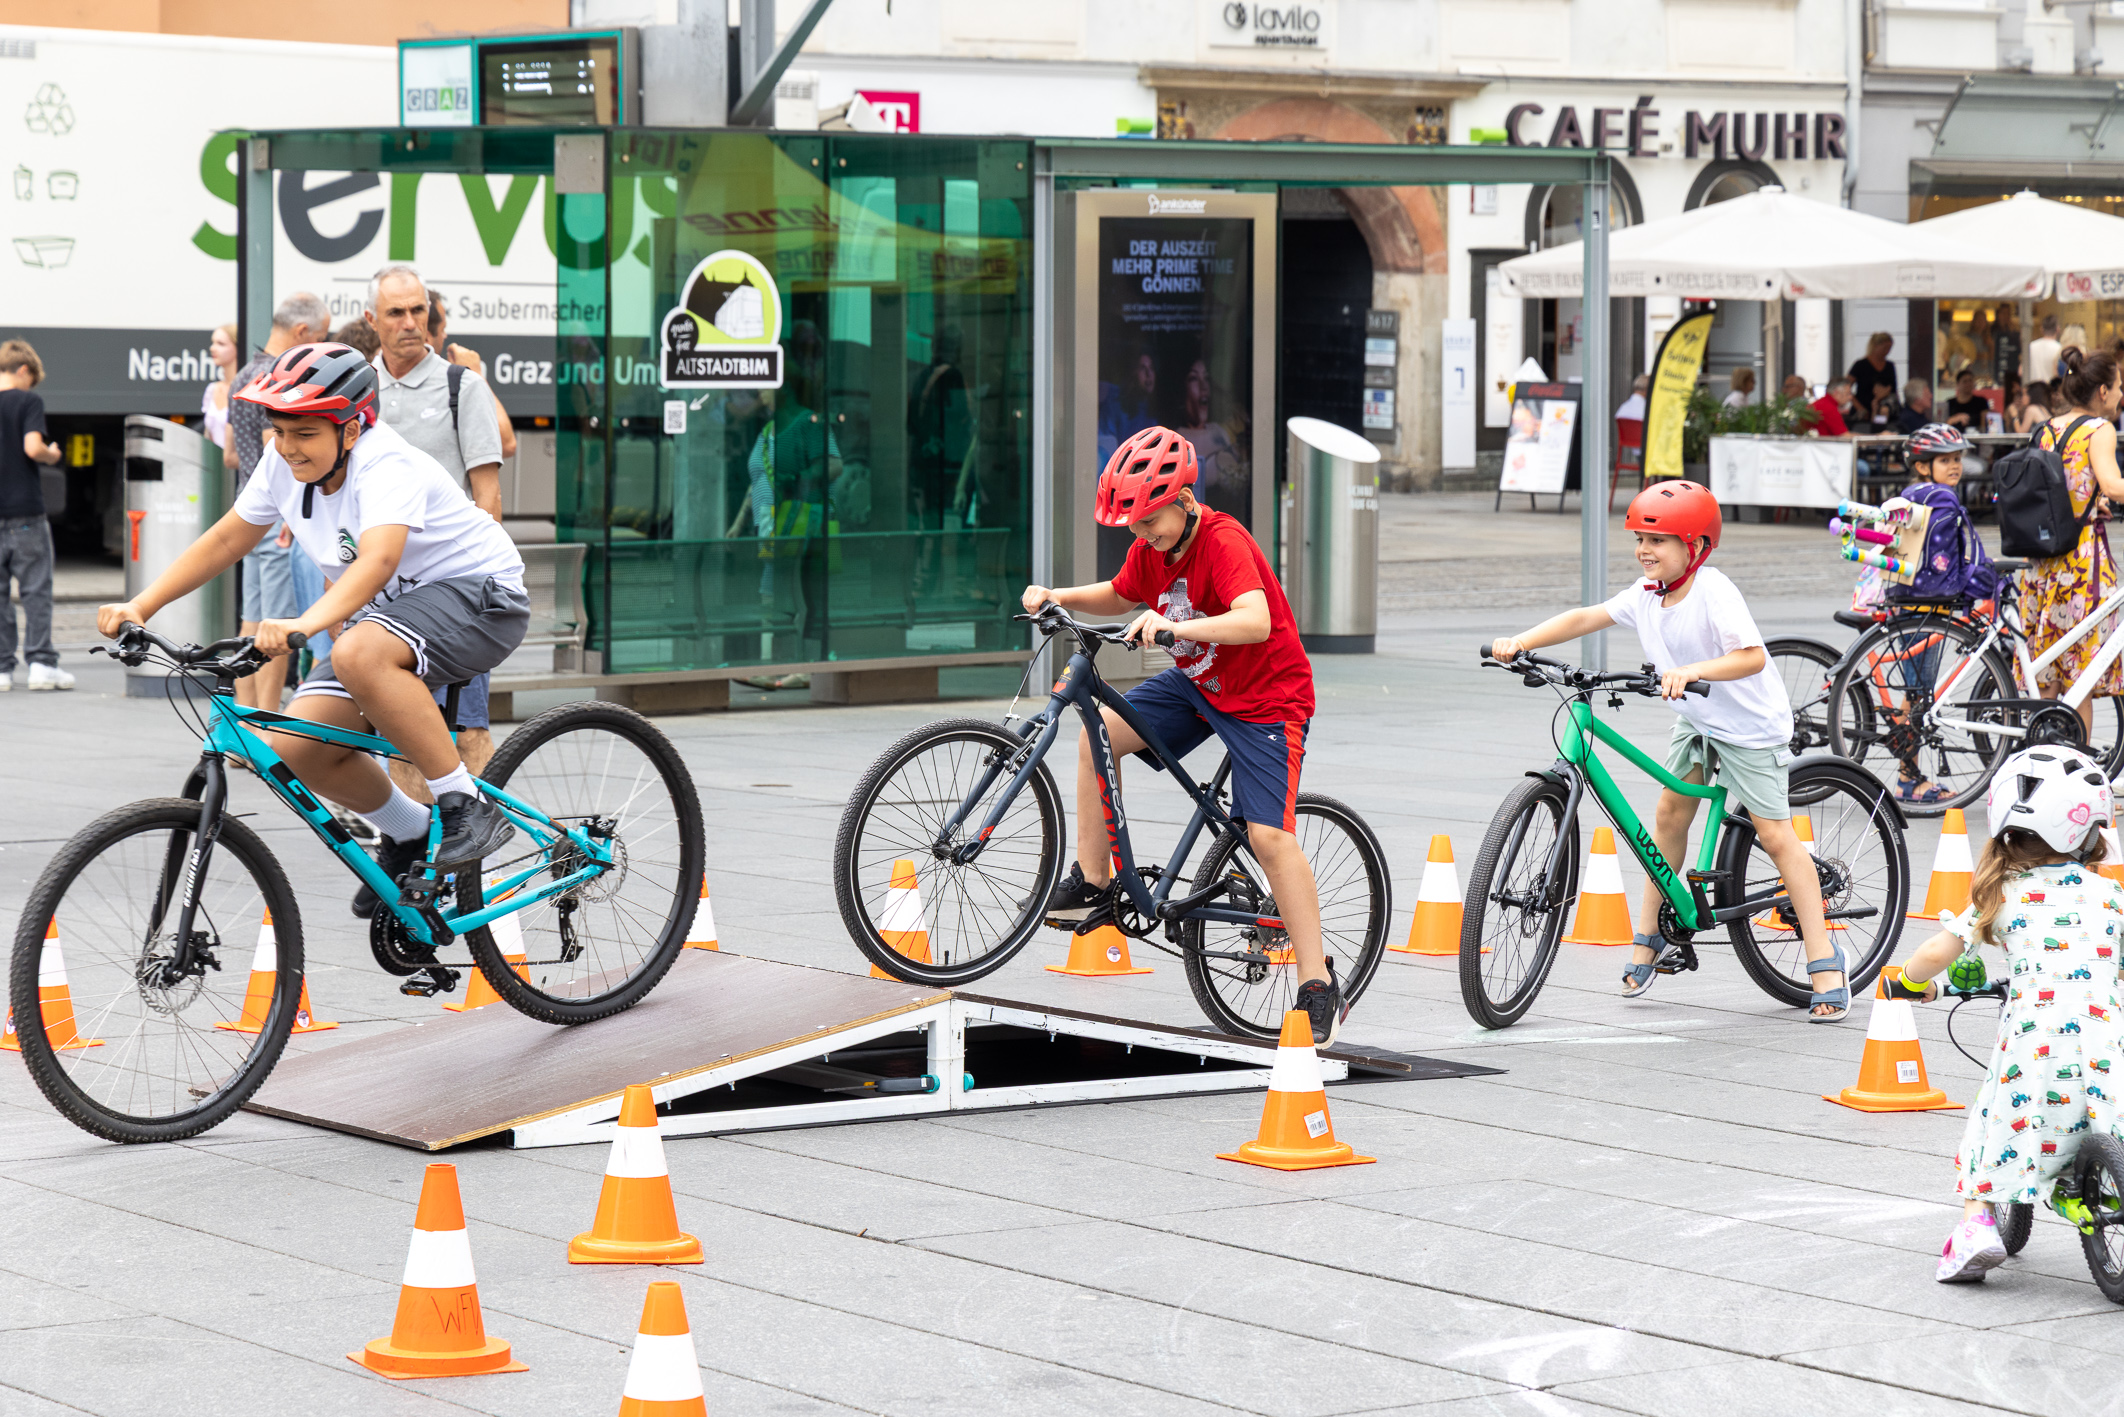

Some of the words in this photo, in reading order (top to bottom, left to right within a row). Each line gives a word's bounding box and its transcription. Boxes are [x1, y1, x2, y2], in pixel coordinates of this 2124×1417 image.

[1254, 4, 1320, 32] lavilo
[407, 88, 468, 111] GRAZ
[1505, 95, 1660, 158] CAFÉ
[1684, 111, 1847, 161] MUHR
[1129, 240, 1157, 256] DER
[1161, 240, 1217, 256] AUSZEIT
[1112, 259, 1152, 274] MEHR
[1156, 259, 1198, 274] PRIME
[1201, 259, 1234, 274] TIME
[458, 296, 605, 322] Saubermacher
[494, 354, 553, 385] Graz
[557, 356, 605, 385] und
[675, 358, 769, 376] ALTSTADTBIM
[1098, 723, 1126, 830] ORBEA
[1636, 822, 1673, 887] woom
